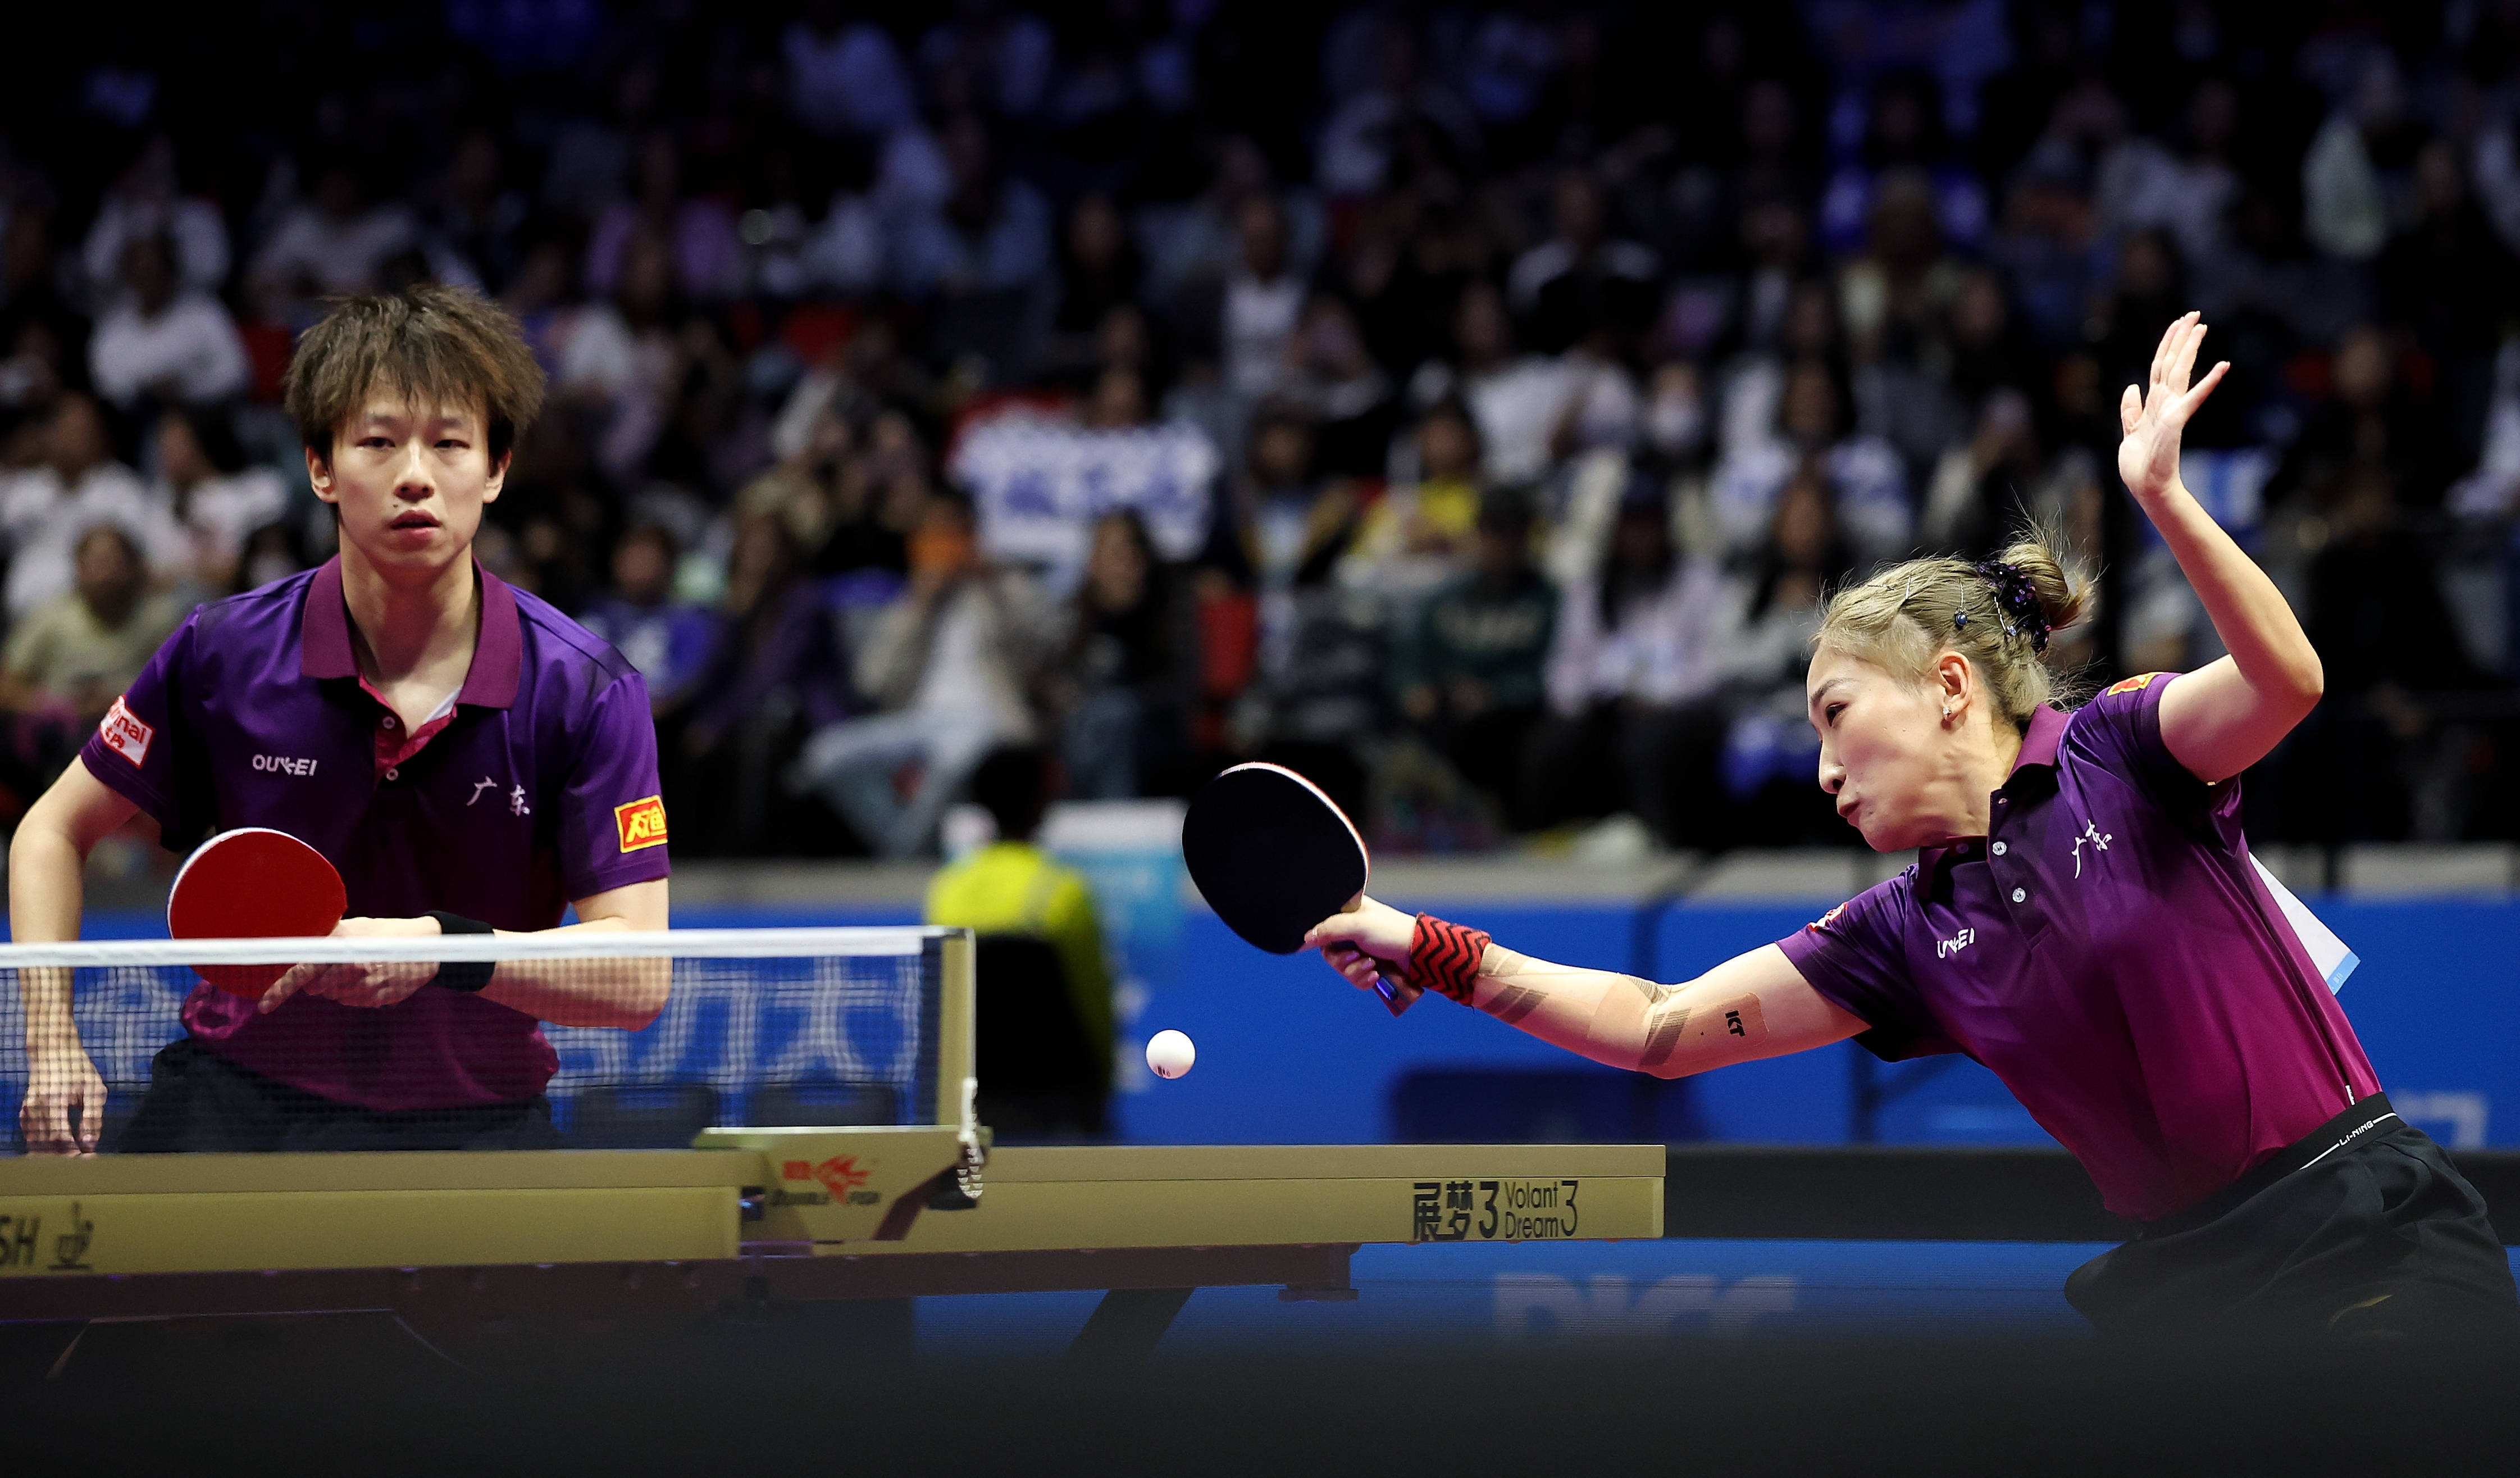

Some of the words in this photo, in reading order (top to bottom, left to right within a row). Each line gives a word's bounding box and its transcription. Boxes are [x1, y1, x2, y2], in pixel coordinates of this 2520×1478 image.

[467, 775, 530, 817] 广东
[2071, 818, 2113, 880] 广东
[2339, 1120, 2374, 1146] LI-NING
[1505, 1181, 1559, 1209] Volant
[1561, 1180, 1579, 1236] 3
[1505, 1211, 1559, 1239] Dream
